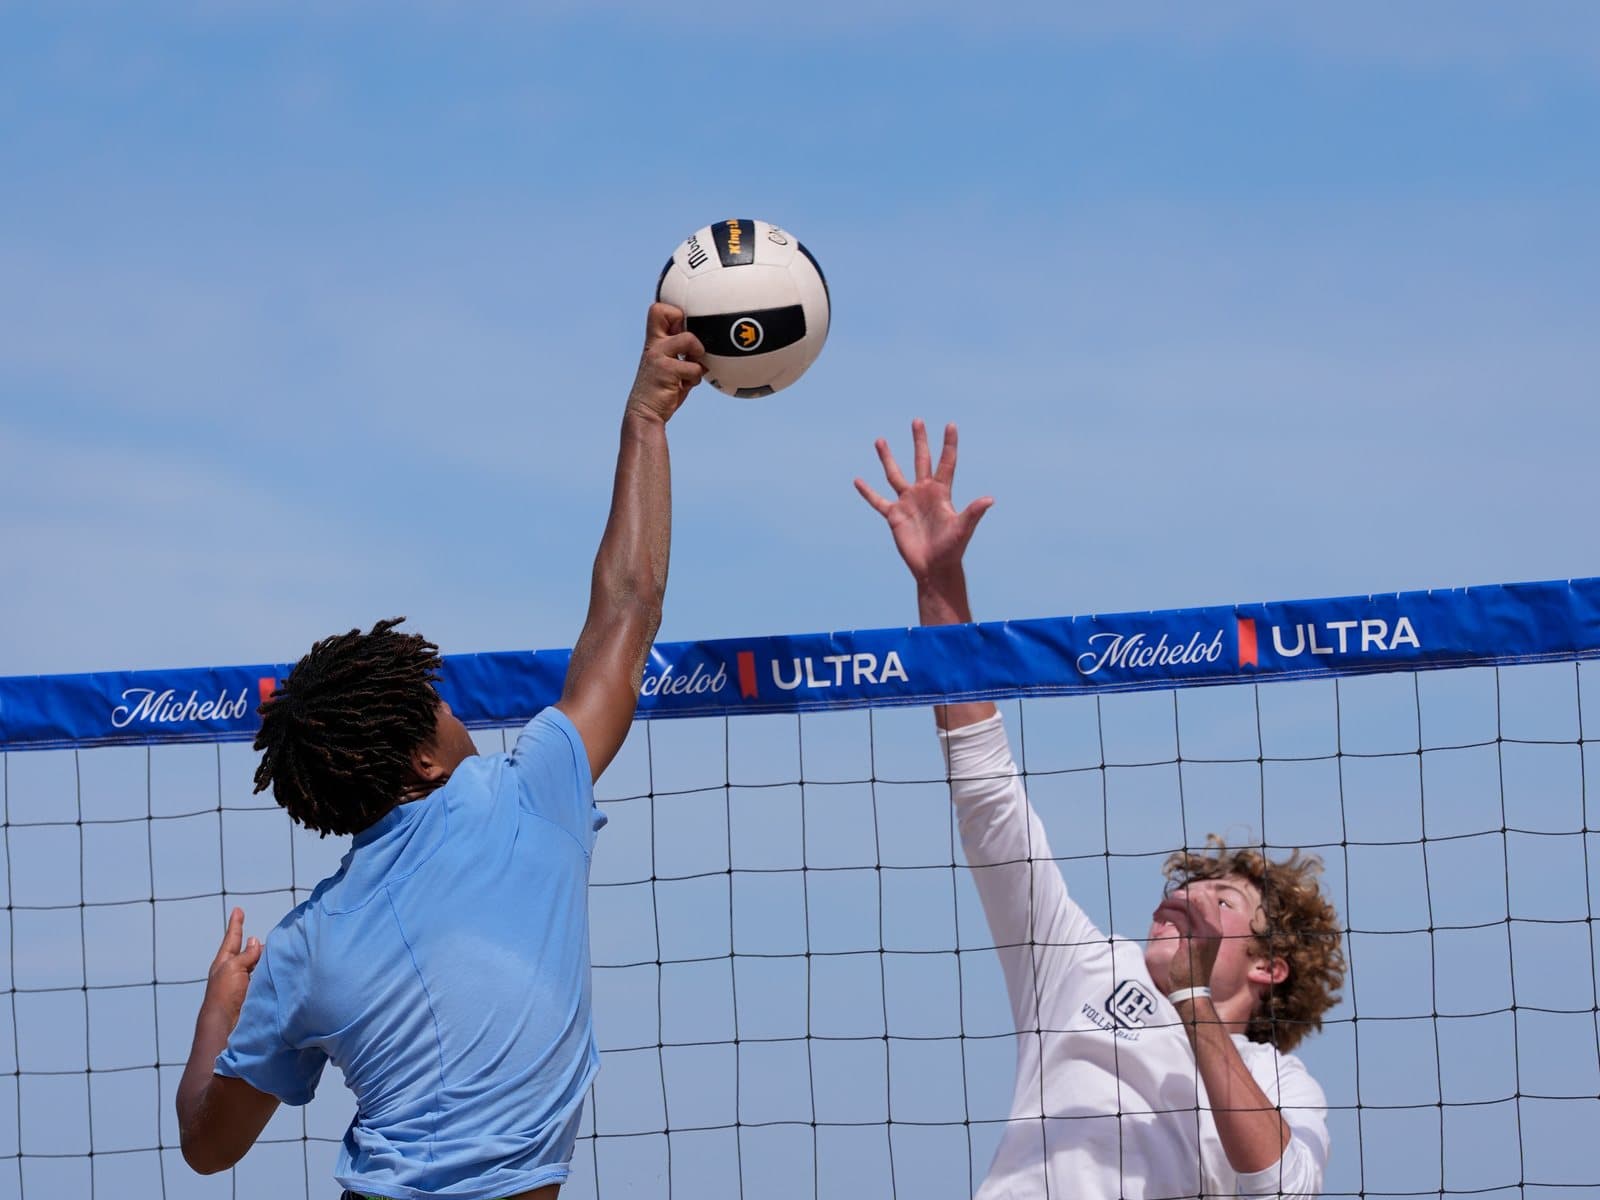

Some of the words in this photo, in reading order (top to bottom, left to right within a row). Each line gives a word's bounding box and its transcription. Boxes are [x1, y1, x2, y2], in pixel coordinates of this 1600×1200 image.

[1076, 629, 1224, 676] Michelob
[1271, 617, 1421, 658] ULTRA
[640, 662, 728, 697] chelob
[771, 651, 910, 691] ULTRA
[111, 688, 248, 728] Michelob
